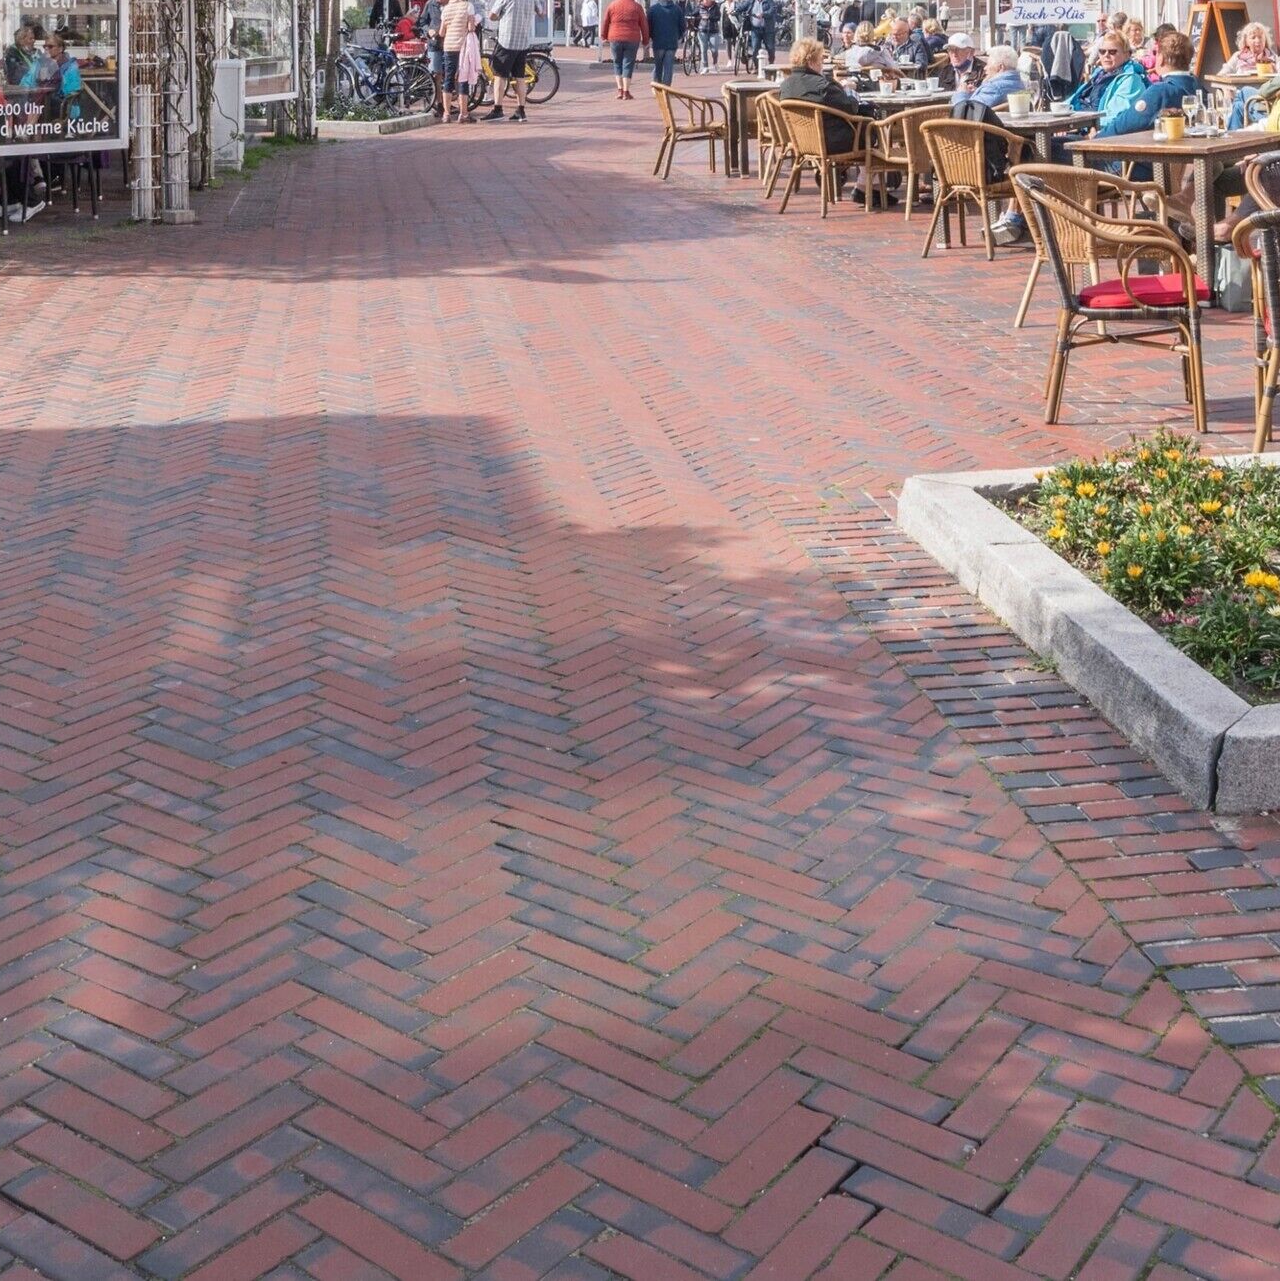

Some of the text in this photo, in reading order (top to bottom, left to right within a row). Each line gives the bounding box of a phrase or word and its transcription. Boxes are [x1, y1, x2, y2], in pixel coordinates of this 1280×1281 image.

[24, 102, 45, 116] Uhr
[14, 121, 62, 136] warme
[66, 118, 110, 135] Küche
